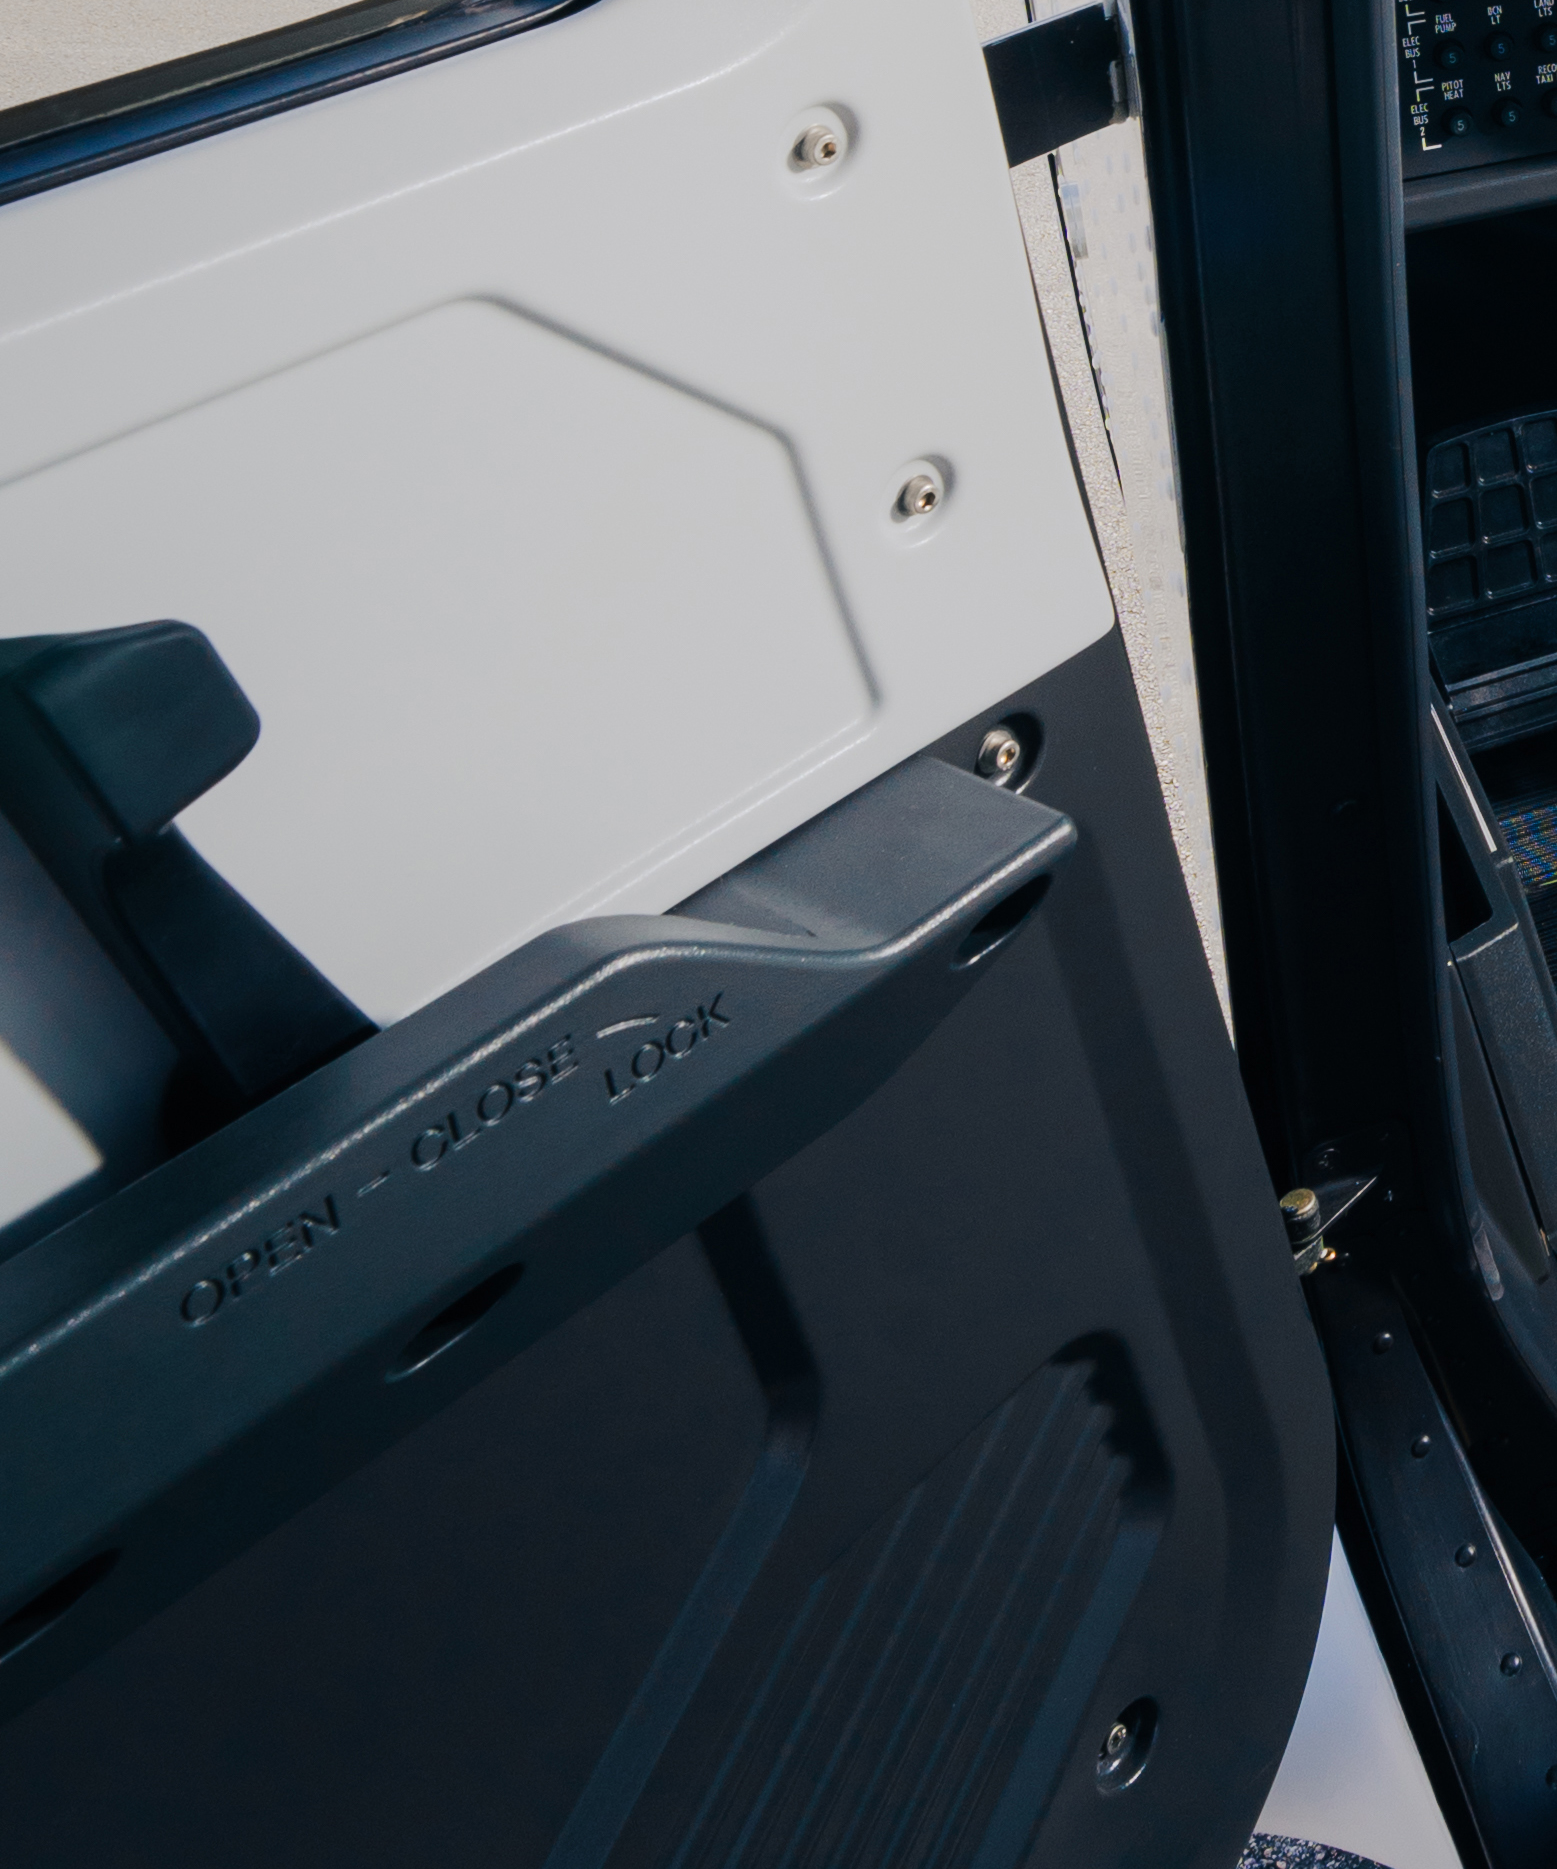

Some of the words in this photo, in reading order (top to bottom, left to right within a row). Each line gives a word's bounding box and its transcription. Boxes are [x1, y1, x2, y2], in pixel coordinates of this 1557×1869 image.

[1538, 7, 1552, 17] LTS
[1435, 14, 1453, 23] FUEL
[1435, 22, 1456, 33] PUMP
[1402, 37, 1420, 47] ELEC
[1405, 48, 1420, 58] BUS
[1495, 72, 1510, 81] NAV
[1536, 74, 1553, 84] TAXI
[1442, 80, 1463, 91] PITOT
[1497, 81, 1511, 91] LTS
[1444, 89, 1463, 100] HEAT
[1411, 104, 1428, 114] ELEC
[1414, 115, 1428, 125] BUS
[604, 992, 732, 1106] LOCK
[178, 1196, 342, 1328] OPEN
[408, 1035, 580, 1171] CLOSE
